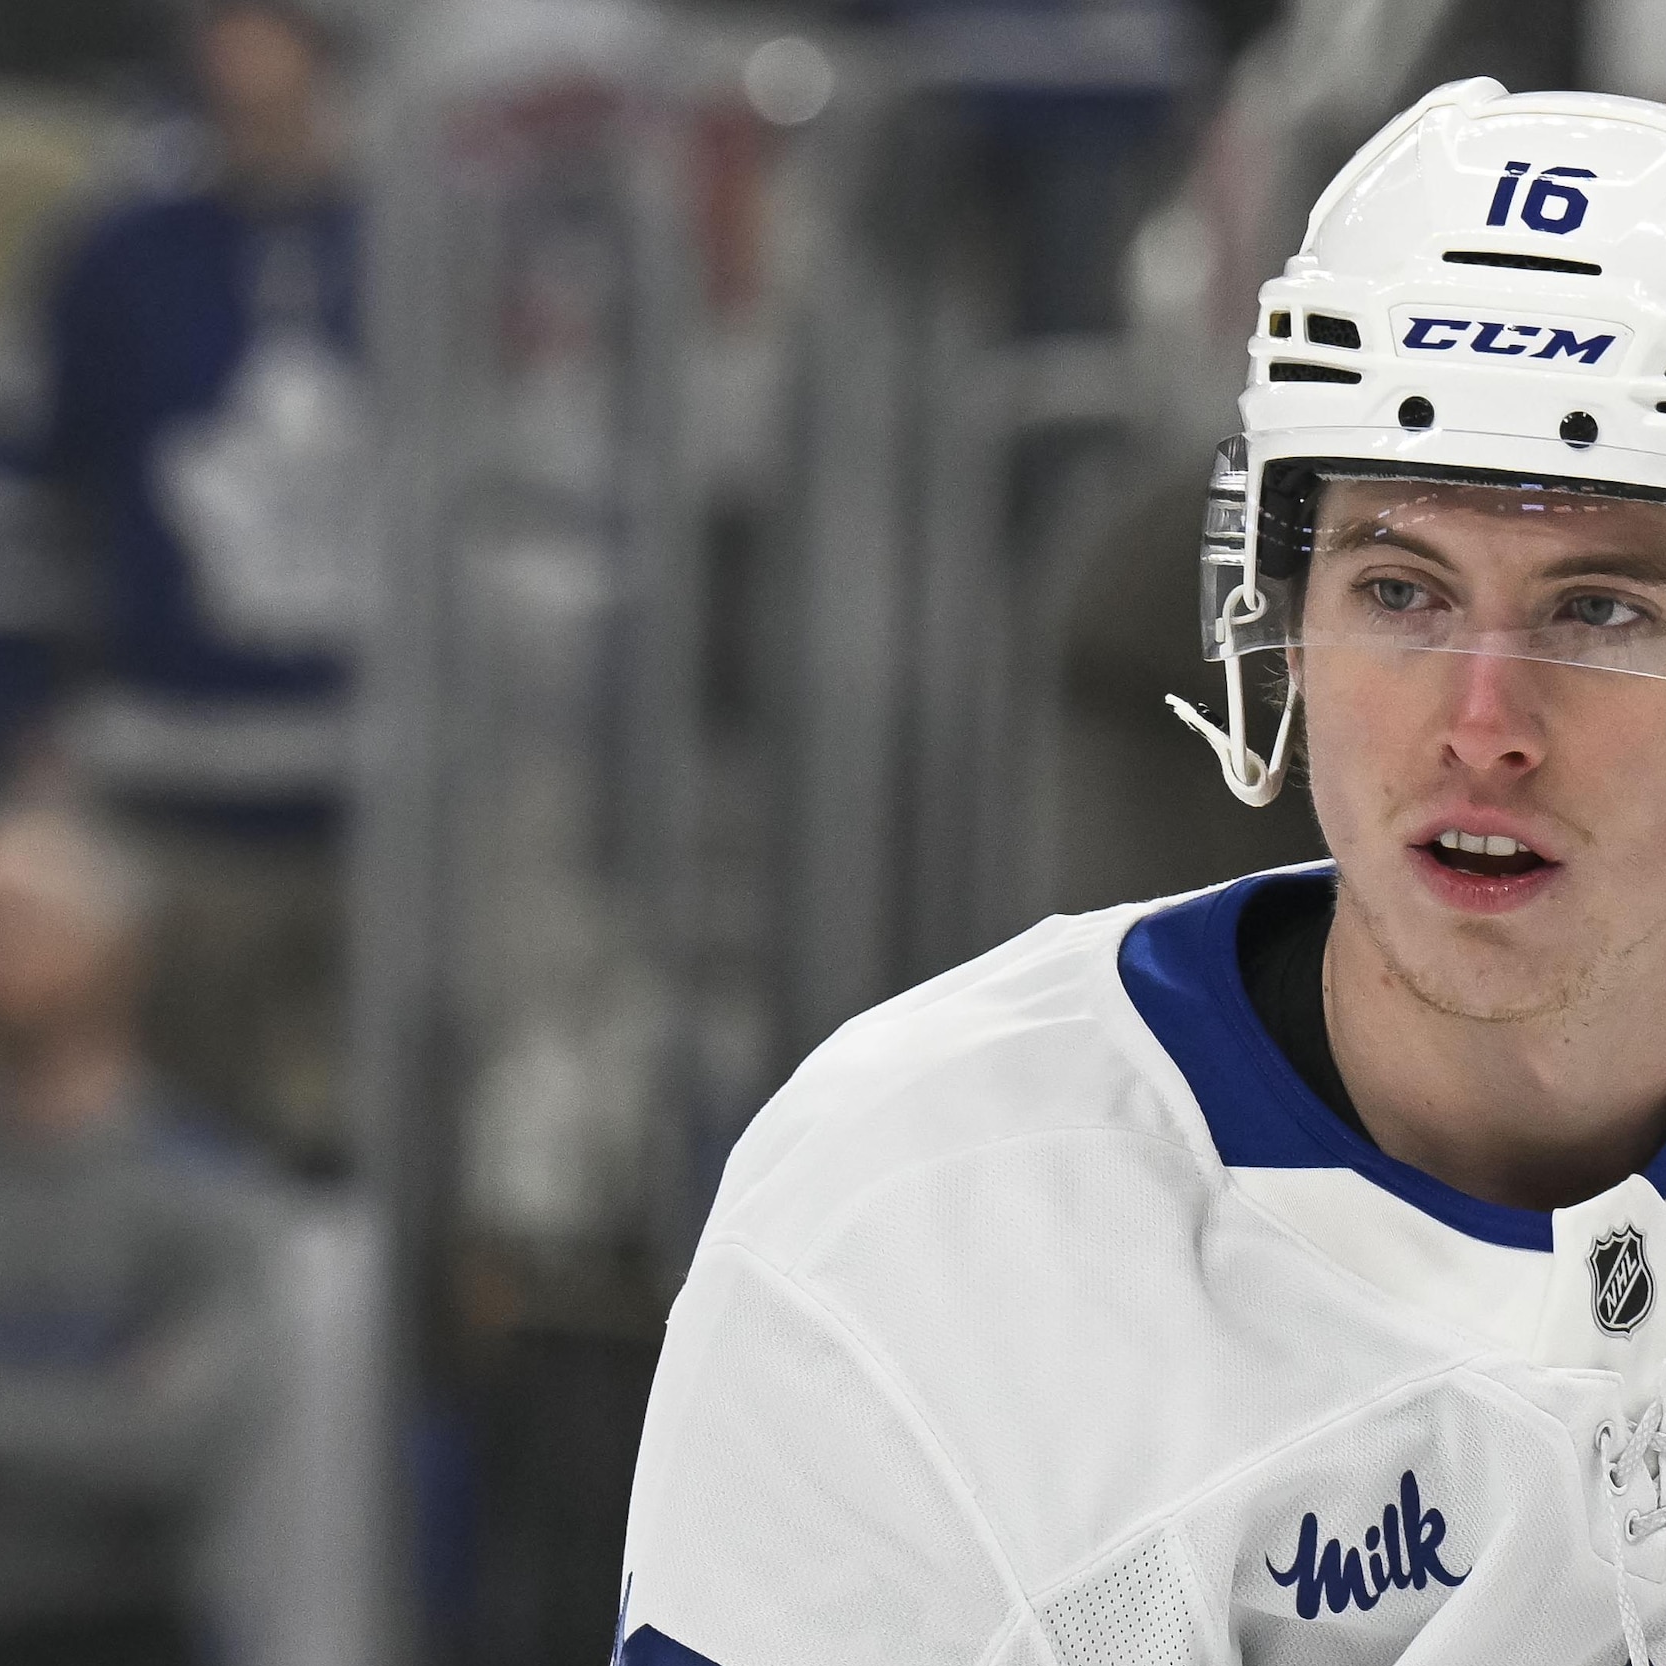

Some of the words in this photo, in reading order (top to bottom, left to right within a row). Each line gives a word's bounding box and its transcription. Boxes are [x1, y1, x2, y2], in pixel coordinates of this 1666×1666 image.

[1485, 160, 1598, 236] 16
[1402, 315, 1617, 365] CCM
[1604, 1249, 1638, 1319] NHL
